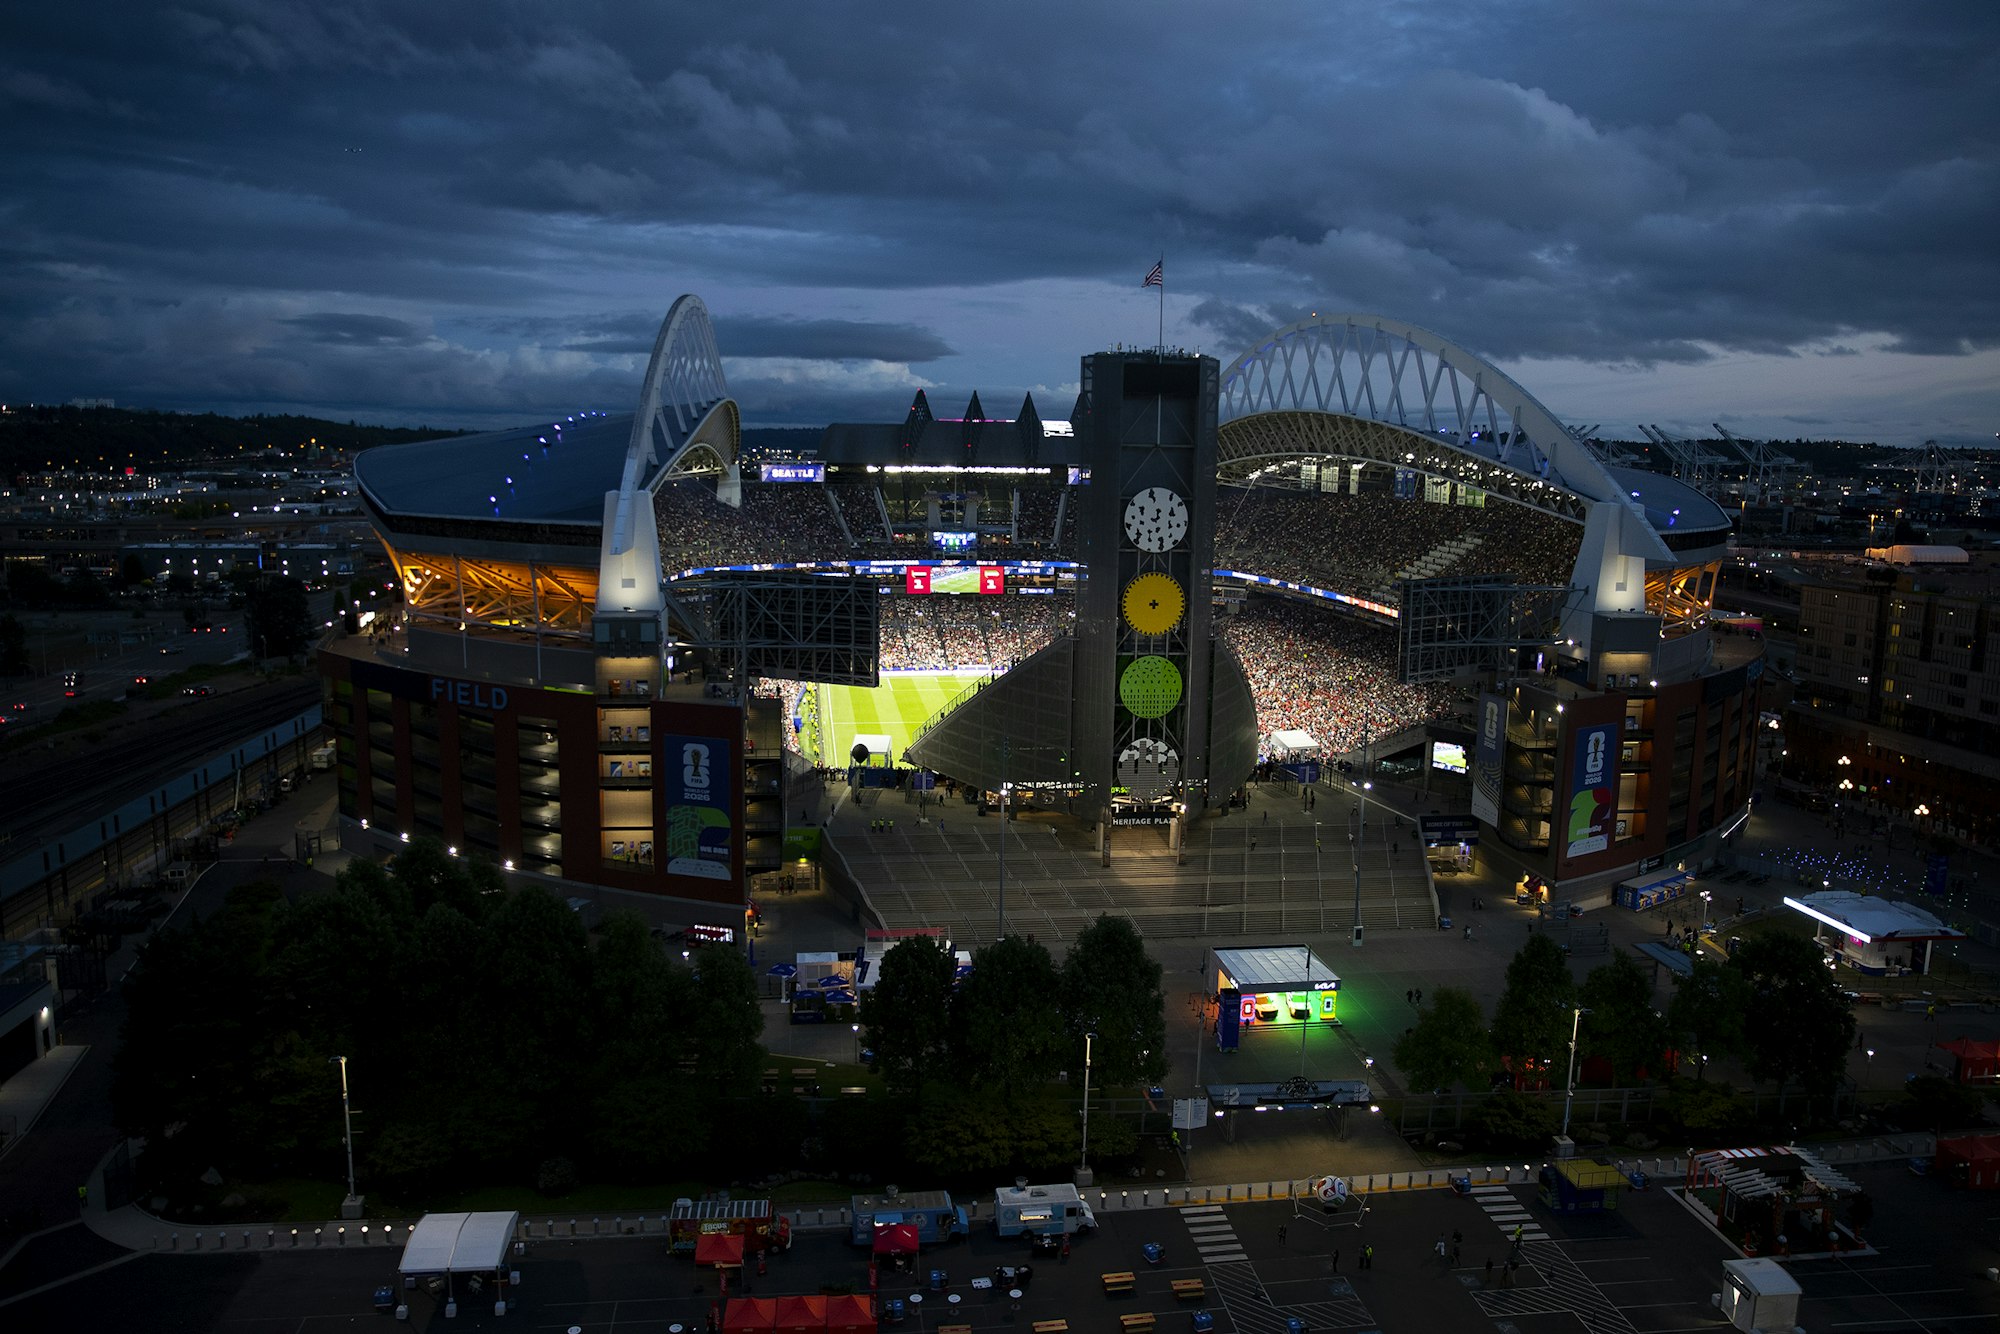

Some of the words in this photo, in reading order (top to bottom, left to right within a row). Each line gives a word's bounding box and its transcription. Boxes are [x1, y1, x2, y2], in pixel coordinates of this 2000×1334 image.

[772, 468, 814, 478] SEATTLE
[431, 677, 509, 711] FIELD
[1584, 777, 1602, 785] 2026
[1112, 818, 1151, 826] HERITAGE
[1154, 817, 1178, 825] PLAA
[1229, 1087, 1240, 1105] 2
[1359, 1083, 1370, 1102] 2
